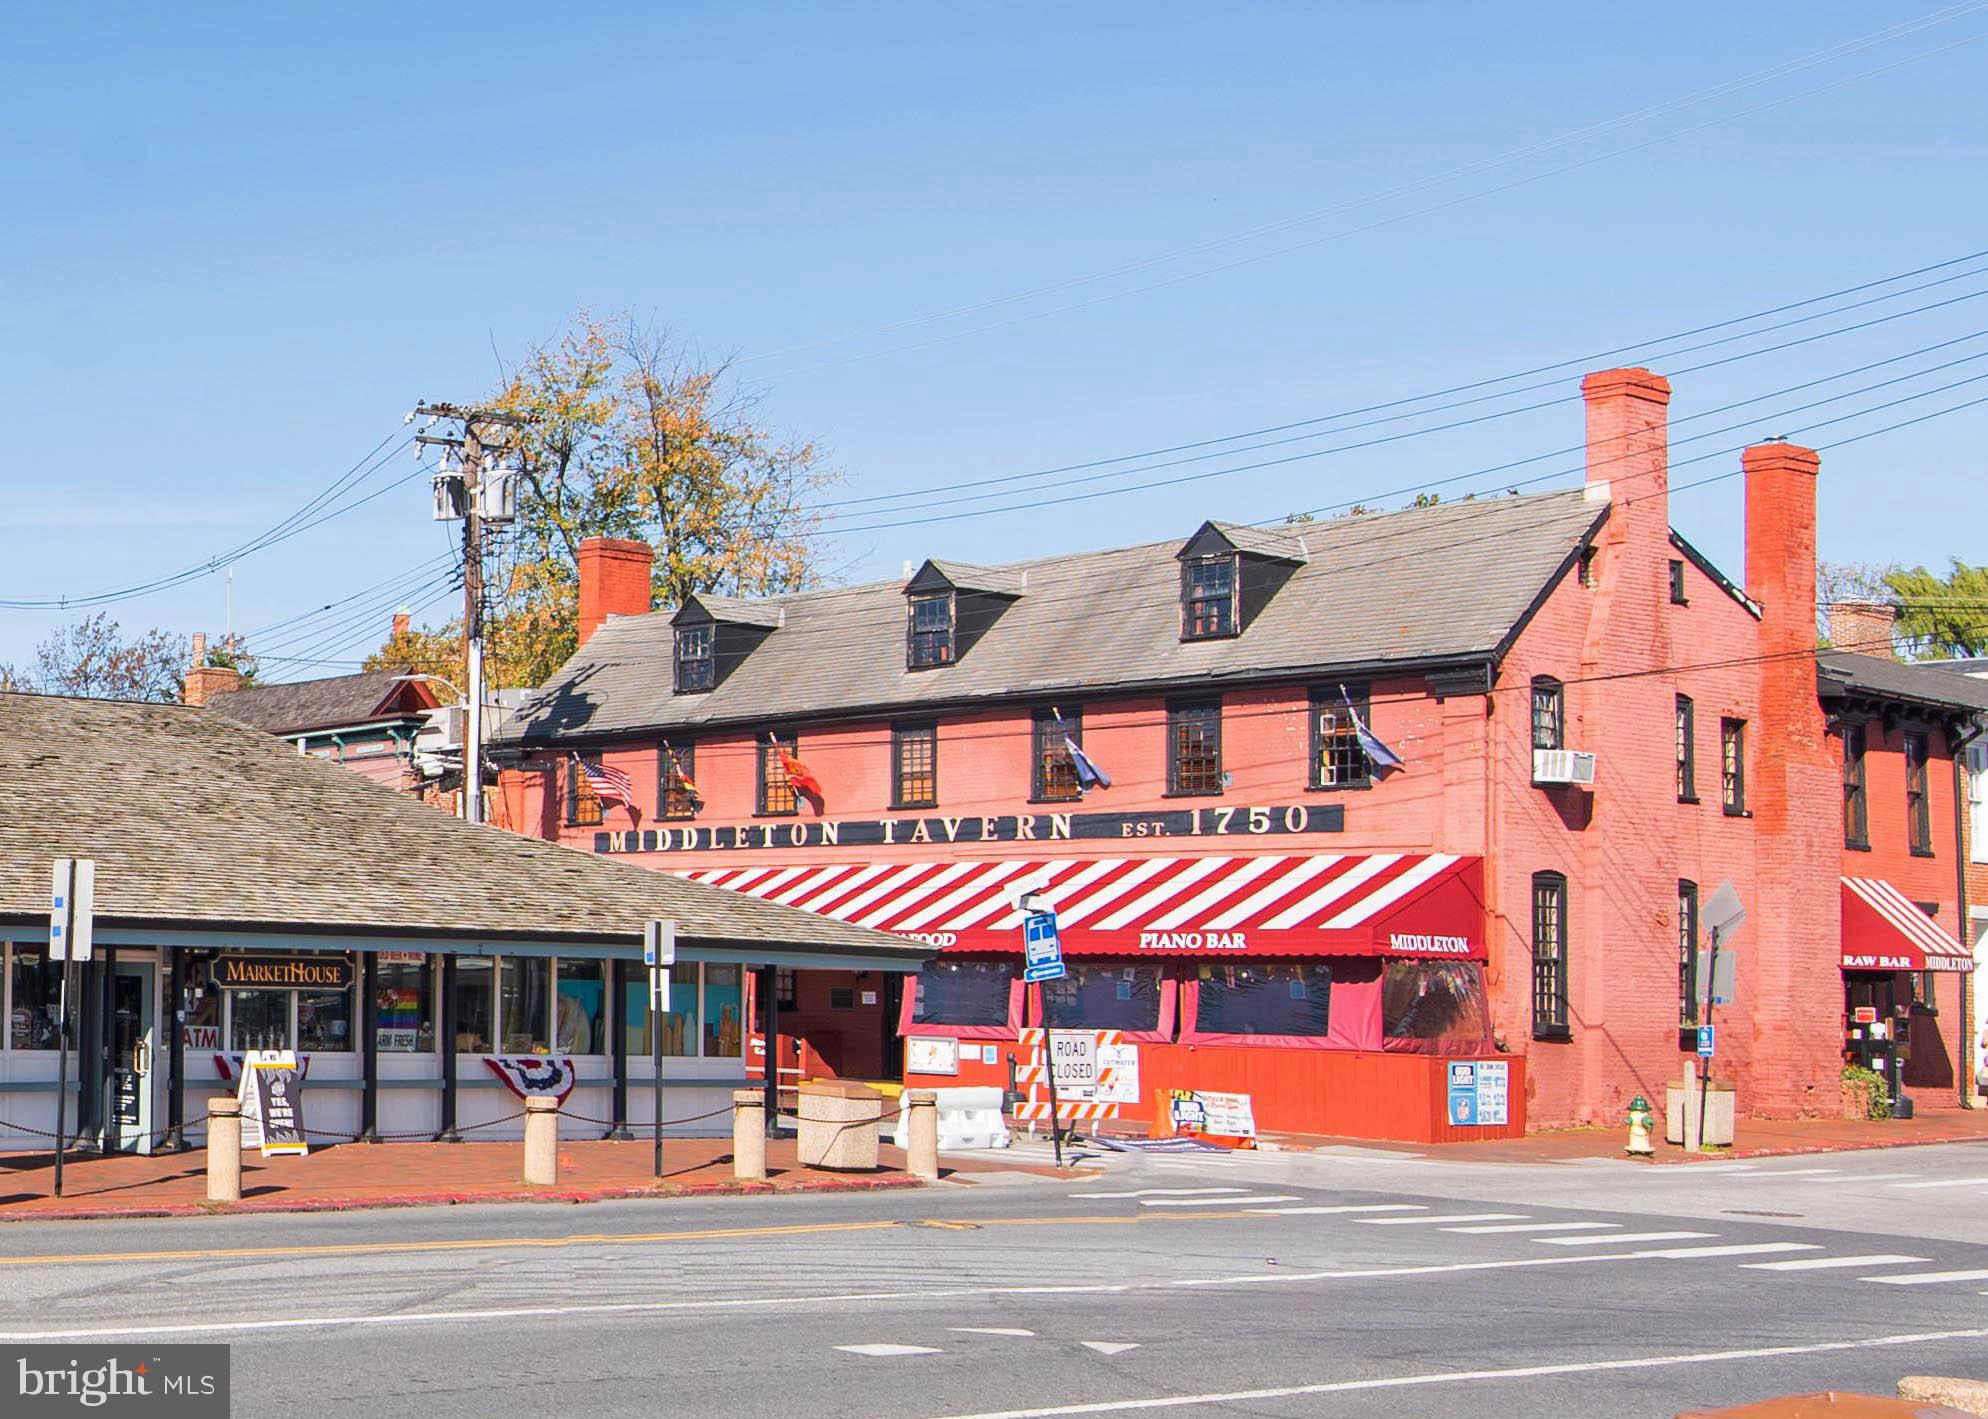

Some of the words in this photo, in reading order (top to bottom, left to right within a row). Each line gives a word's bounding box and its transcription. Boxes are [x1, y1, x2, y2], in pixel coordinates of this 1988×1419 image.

[609, 821, 840, 852] MIDDLETON
[879, 813, 1073, 843] TAVERN
[1121, 822, 1171, 837] EST.
[1190, 805, 1309, 835] 1750
[1139, 932, 1203, 949] PIANO
[1205, 932, 1248, 949] BAR
[1389, 933, 1470, 953] MIDDLETON
[1843, 955, 1877, 966] RAW
[1879, 956, 1912, 968] BAR
[1925, 955, 1974, 971] MIDDLETON
[183, 1027, 217, 1049] ATM
[379, 1033, 392, 1047] ARM
[1057, 1041, 1086, 1057] ROAD
[1454, 1066, 1472, 1076] BUD
[1452, 1075, 1474, 1085] LIGHT
[1178, 1101, 1201, 1112] BUD
[1174, 1110, 1205, 1122] LIGHT
